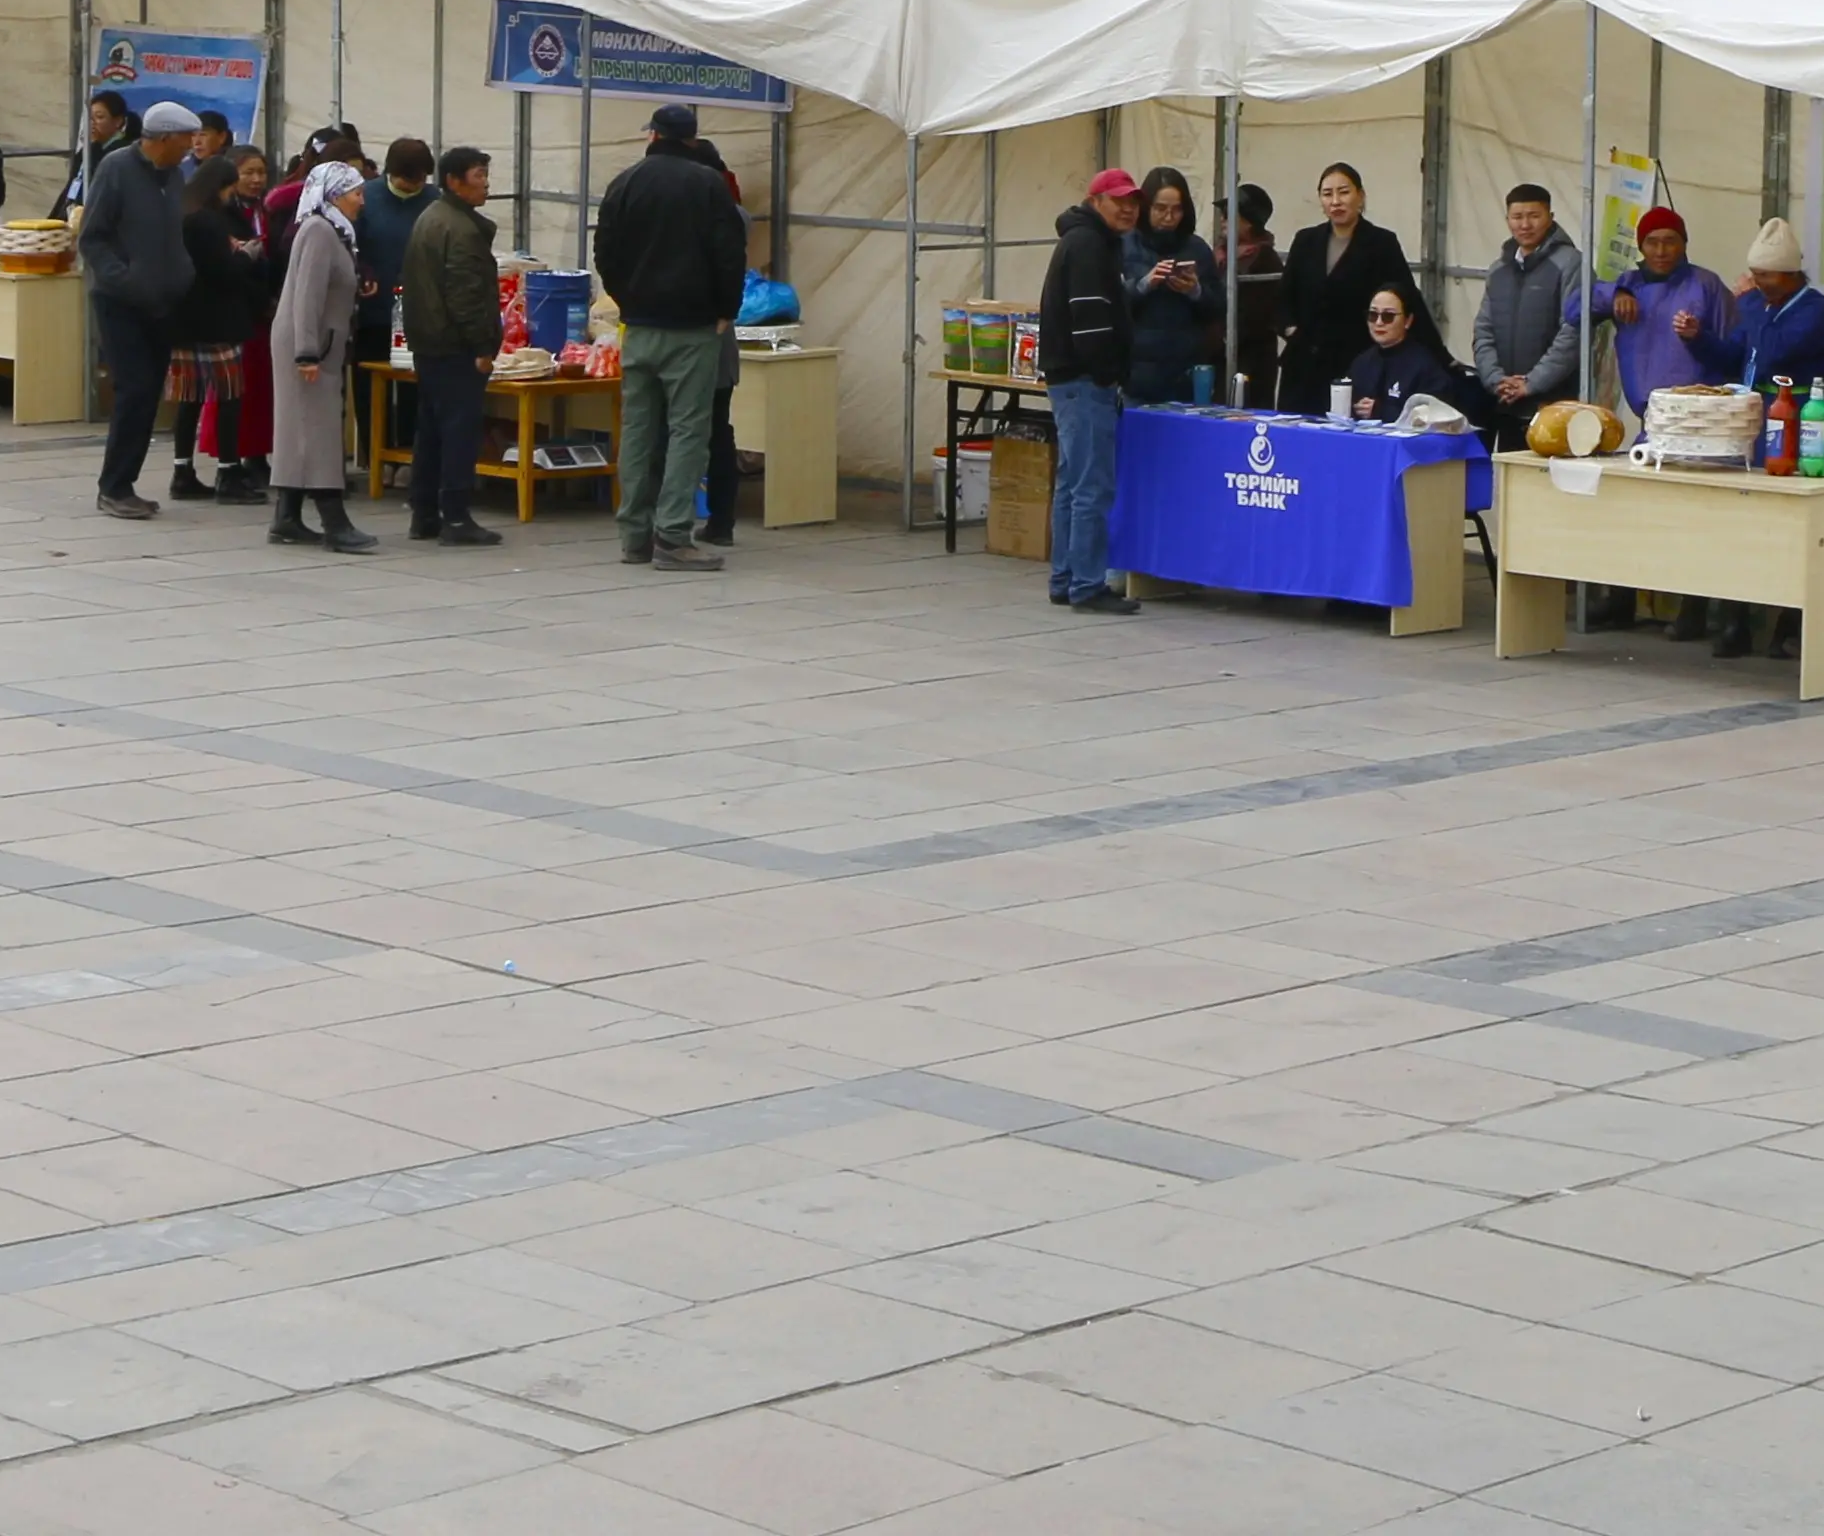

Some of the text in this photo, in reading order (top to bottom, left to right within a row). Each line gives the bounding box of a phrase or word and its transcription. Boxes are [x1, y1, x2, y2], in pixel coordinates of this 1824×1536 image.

[637, 62, 695, 85] НОГООН
[1224, 472, 1299, 495] ТӨРИЙН
[1236, 489, 1287, 511] БАНК
